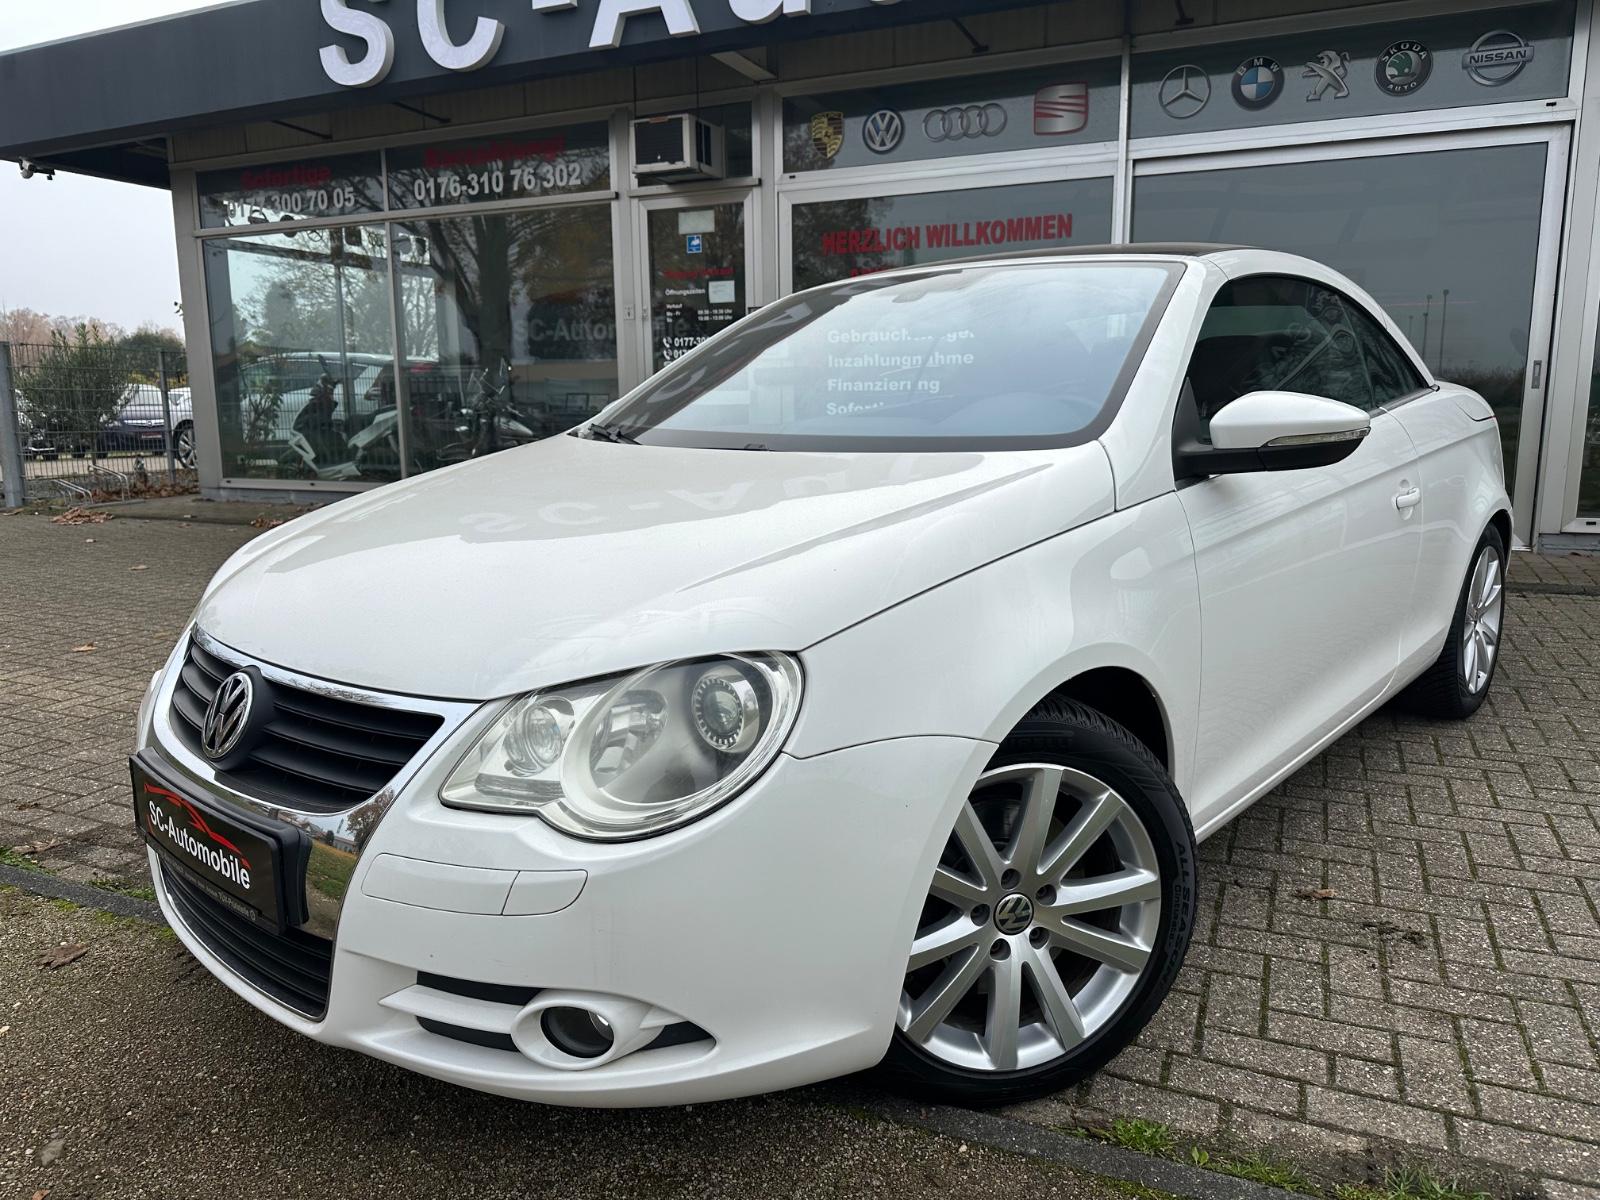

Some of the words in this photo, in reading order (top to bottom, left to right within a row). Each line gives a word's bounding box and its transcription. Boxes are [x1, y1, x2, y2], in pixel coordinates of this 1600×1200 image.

[1236, 57, 1280, 76] BMW
[1469, 49, 1527, 64] NISSAN
[1387, 81, 1418, 92] AUTO
[414, 171, 503, 201] 0176-310
[510, 167, 536, 192] 76
[542, 161, 581, 189] 302
[308, 190, 328, 211] 70
[333, 187, 355, 207] 05
[821, 226, 920, 256] HERZLICH
[926, 213, 1073, 249] WILLKOMMEN
[149, 800, 251, 890] SC-Automobile
[1175, 841, 1191, 882] ALL
